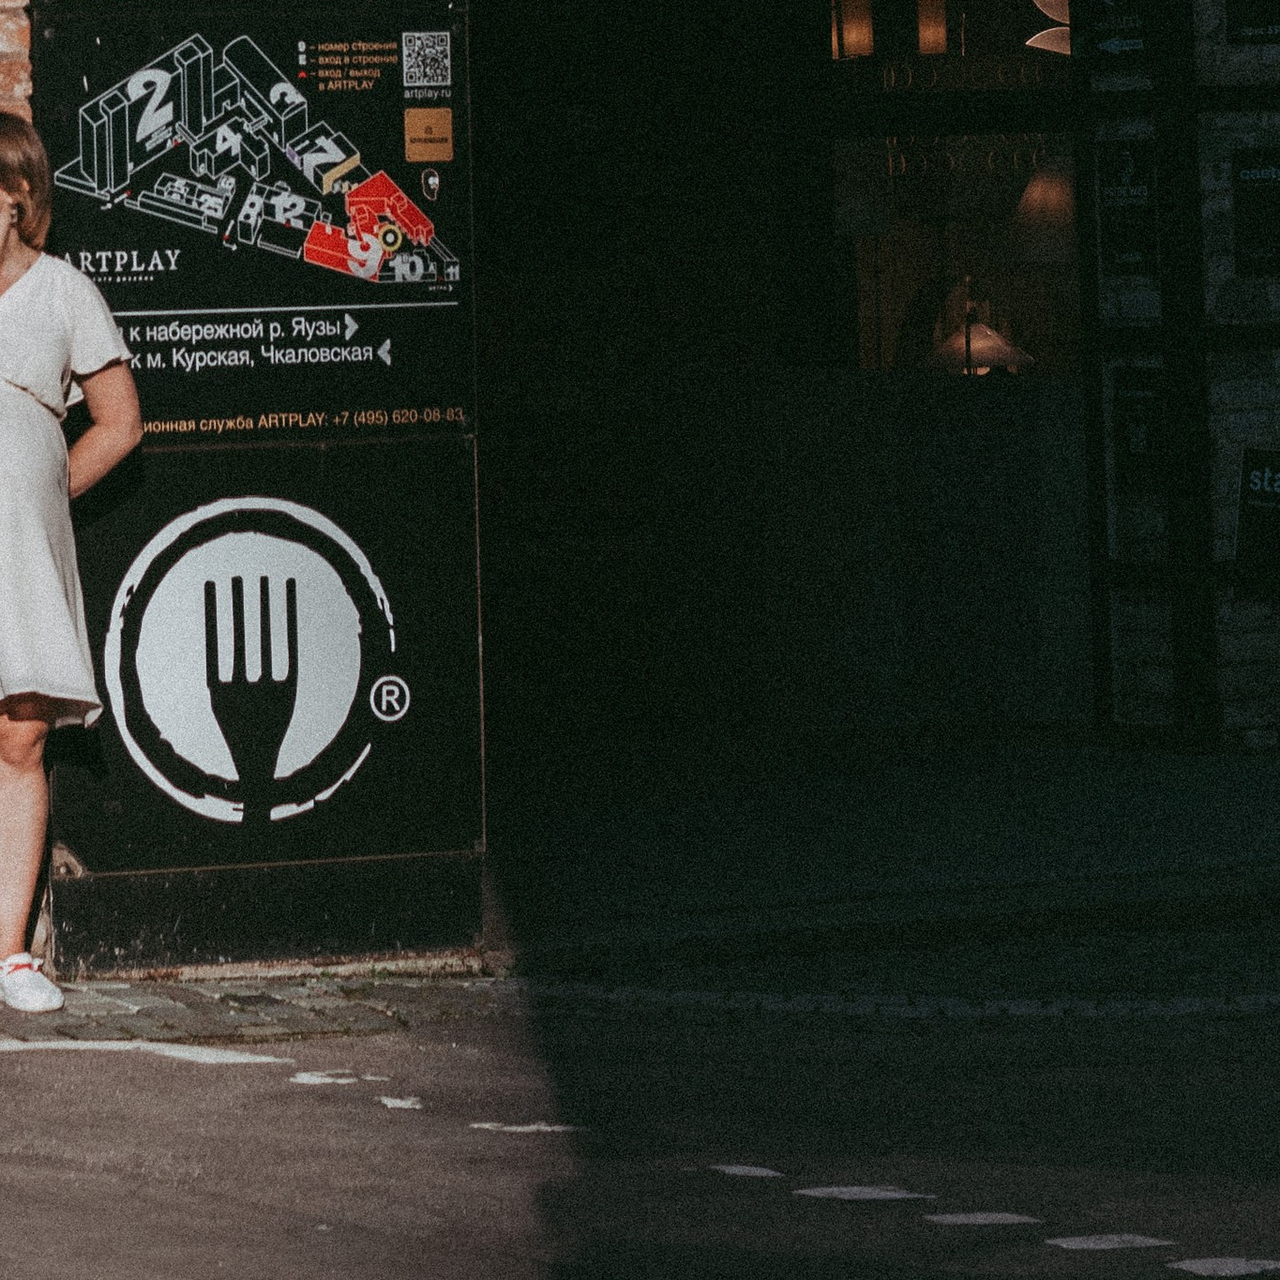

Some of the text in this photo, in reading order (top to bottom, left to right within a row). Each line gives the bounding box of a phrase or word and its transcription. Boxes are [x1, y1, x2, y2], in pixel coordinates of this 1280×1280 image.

[63, 251, 181, 273] RTPLAY
[130, 327, 140, 341] к
[146, 319, 263, 343] набережной
[270, 322, 284, 341] р.
[292, 317, 340, 341] Яузы
[147, 353, 166, 368] м.
[172, 348, 254, 372] Курская,
[261, 345, 373, 363] Чкаловская
[200, 416, 253, 433] служба
[333, 411, 349, 424] +7
[354, 410, 388, 426] (495)
